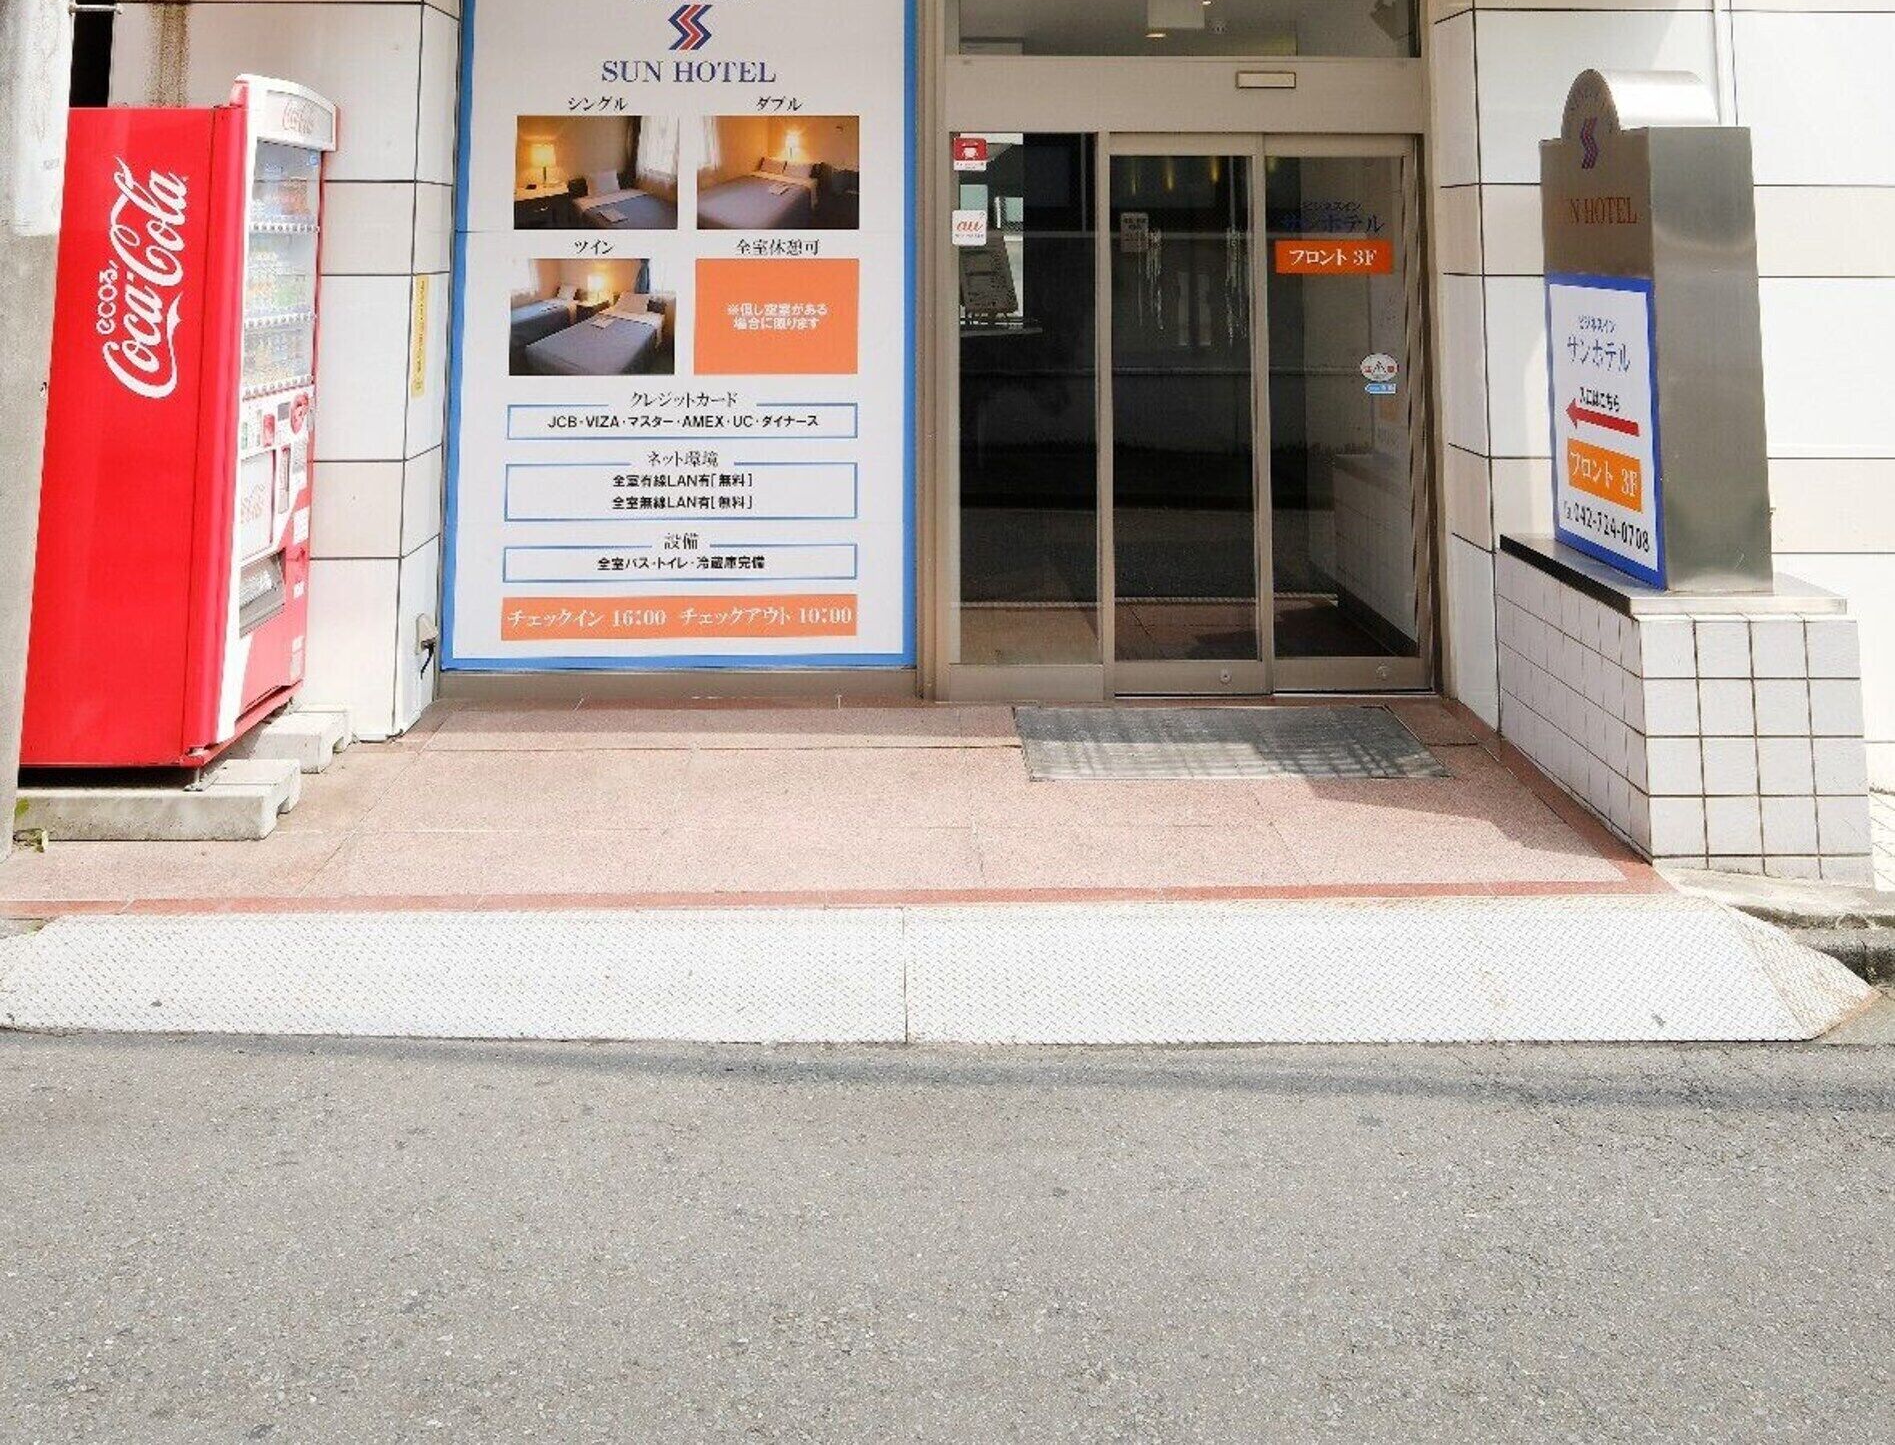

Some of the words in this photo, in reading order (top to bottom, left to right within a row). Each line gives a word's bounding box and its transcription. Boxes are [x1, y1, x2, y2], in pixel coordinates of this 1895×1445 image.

[601, 60, 664, 83] SUN
[672, 60, 777, 83] HOTEL
[567, 95, 629, 112] シングル
[755, 95, 803, 112] ダブル
[1584, 196, 1637, 224] HOTEL
[574, 238, 616, 256] ツイン
[734, 238, 821, 256] 全室休憩可
[1288, 248, 1348, 266] フロント
[1353, 249, 1377, 266] 3F
[102, 155, 189, 400] Coca-Cola
[1567, 335, 1631, 372] サンホテル
[630, 391, 738, 409] クレジットカード
[647, 450, 719, 468] ネット環境
[1570, 451, 1613, 489] フロント
[1621, 468, 1638, 497] 3F
[664, 533, 699, 550] 設備
[507, 609, 603, 627] チェックイン
[612, 609, 667, 626] 16:00
[681, 607, 791, 625] チェックアウト
[800, 607, 852, 624] 10:00
